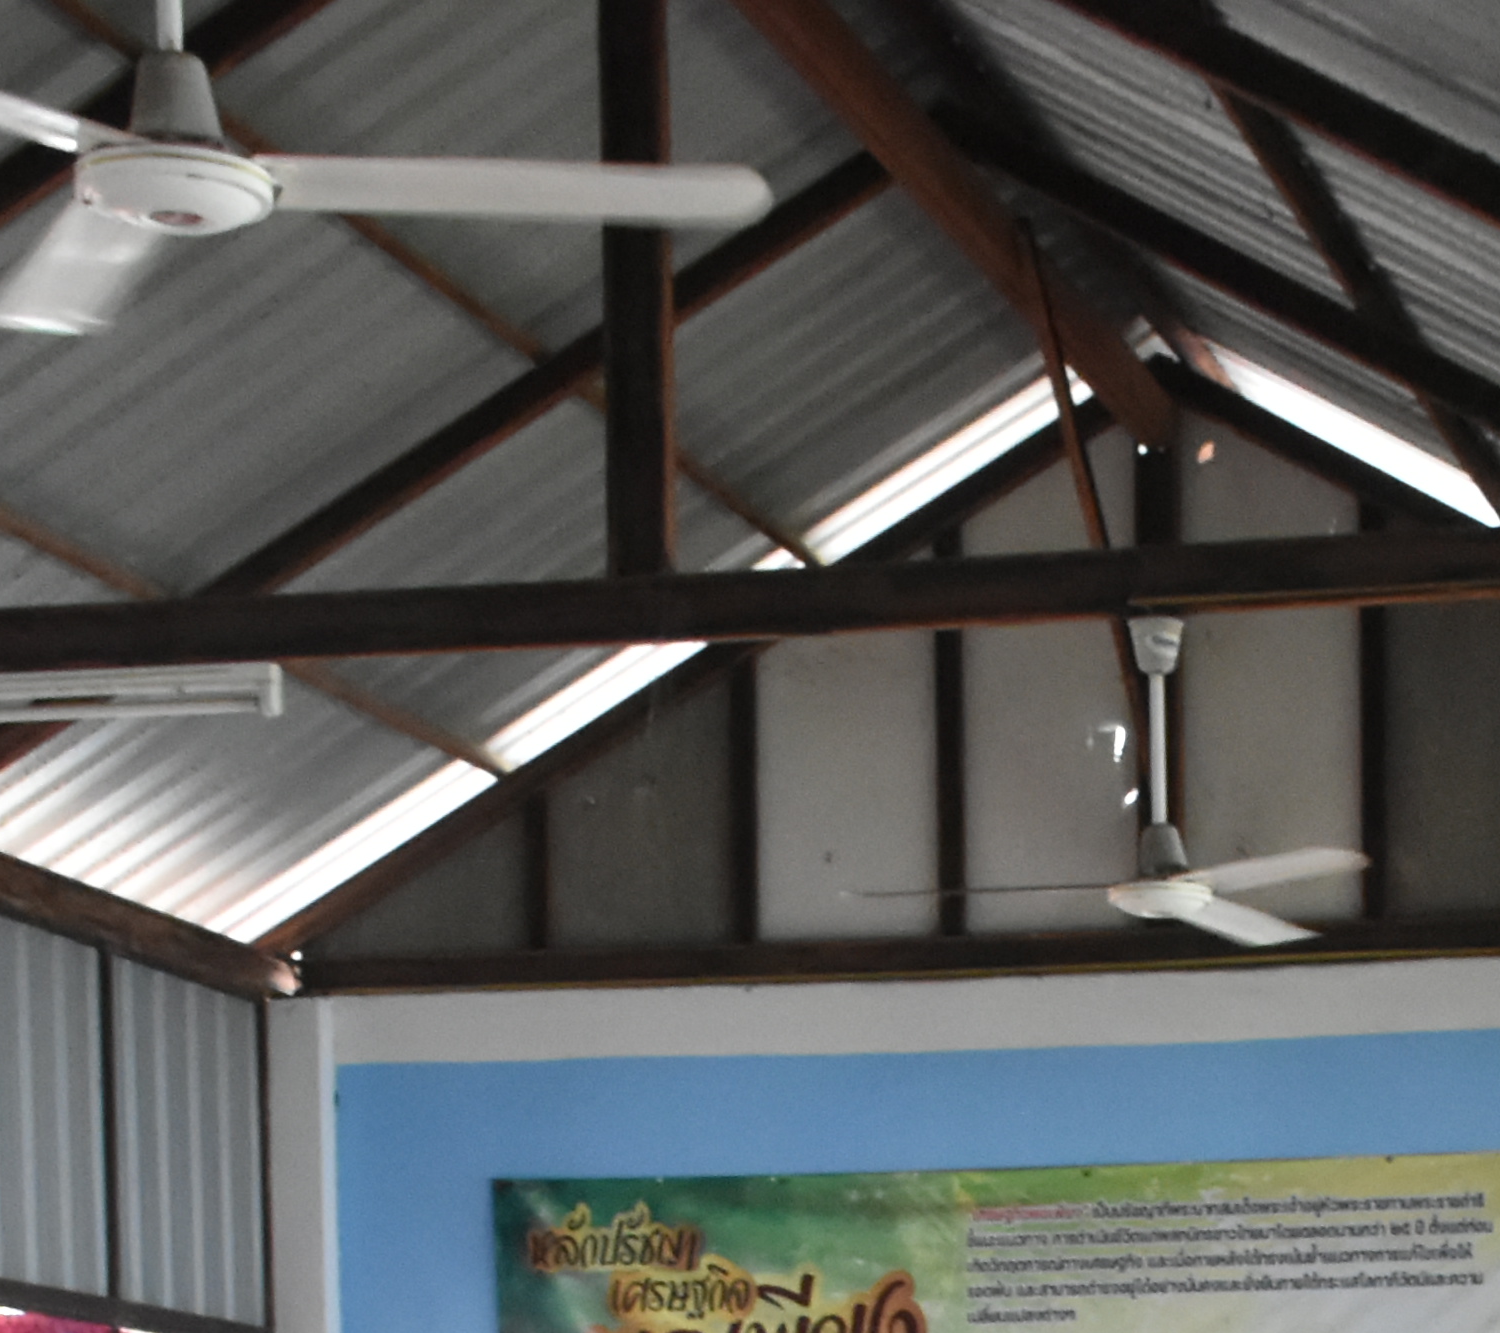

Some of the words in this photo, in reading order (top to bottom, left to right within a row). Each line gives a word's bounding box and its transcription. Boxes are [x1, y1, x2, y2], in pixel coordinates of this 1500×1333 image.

[530, 1205, 698, 1269] หลักปรัชญา
[614, 1262, 752, 1320] เศรษฐกิจ
